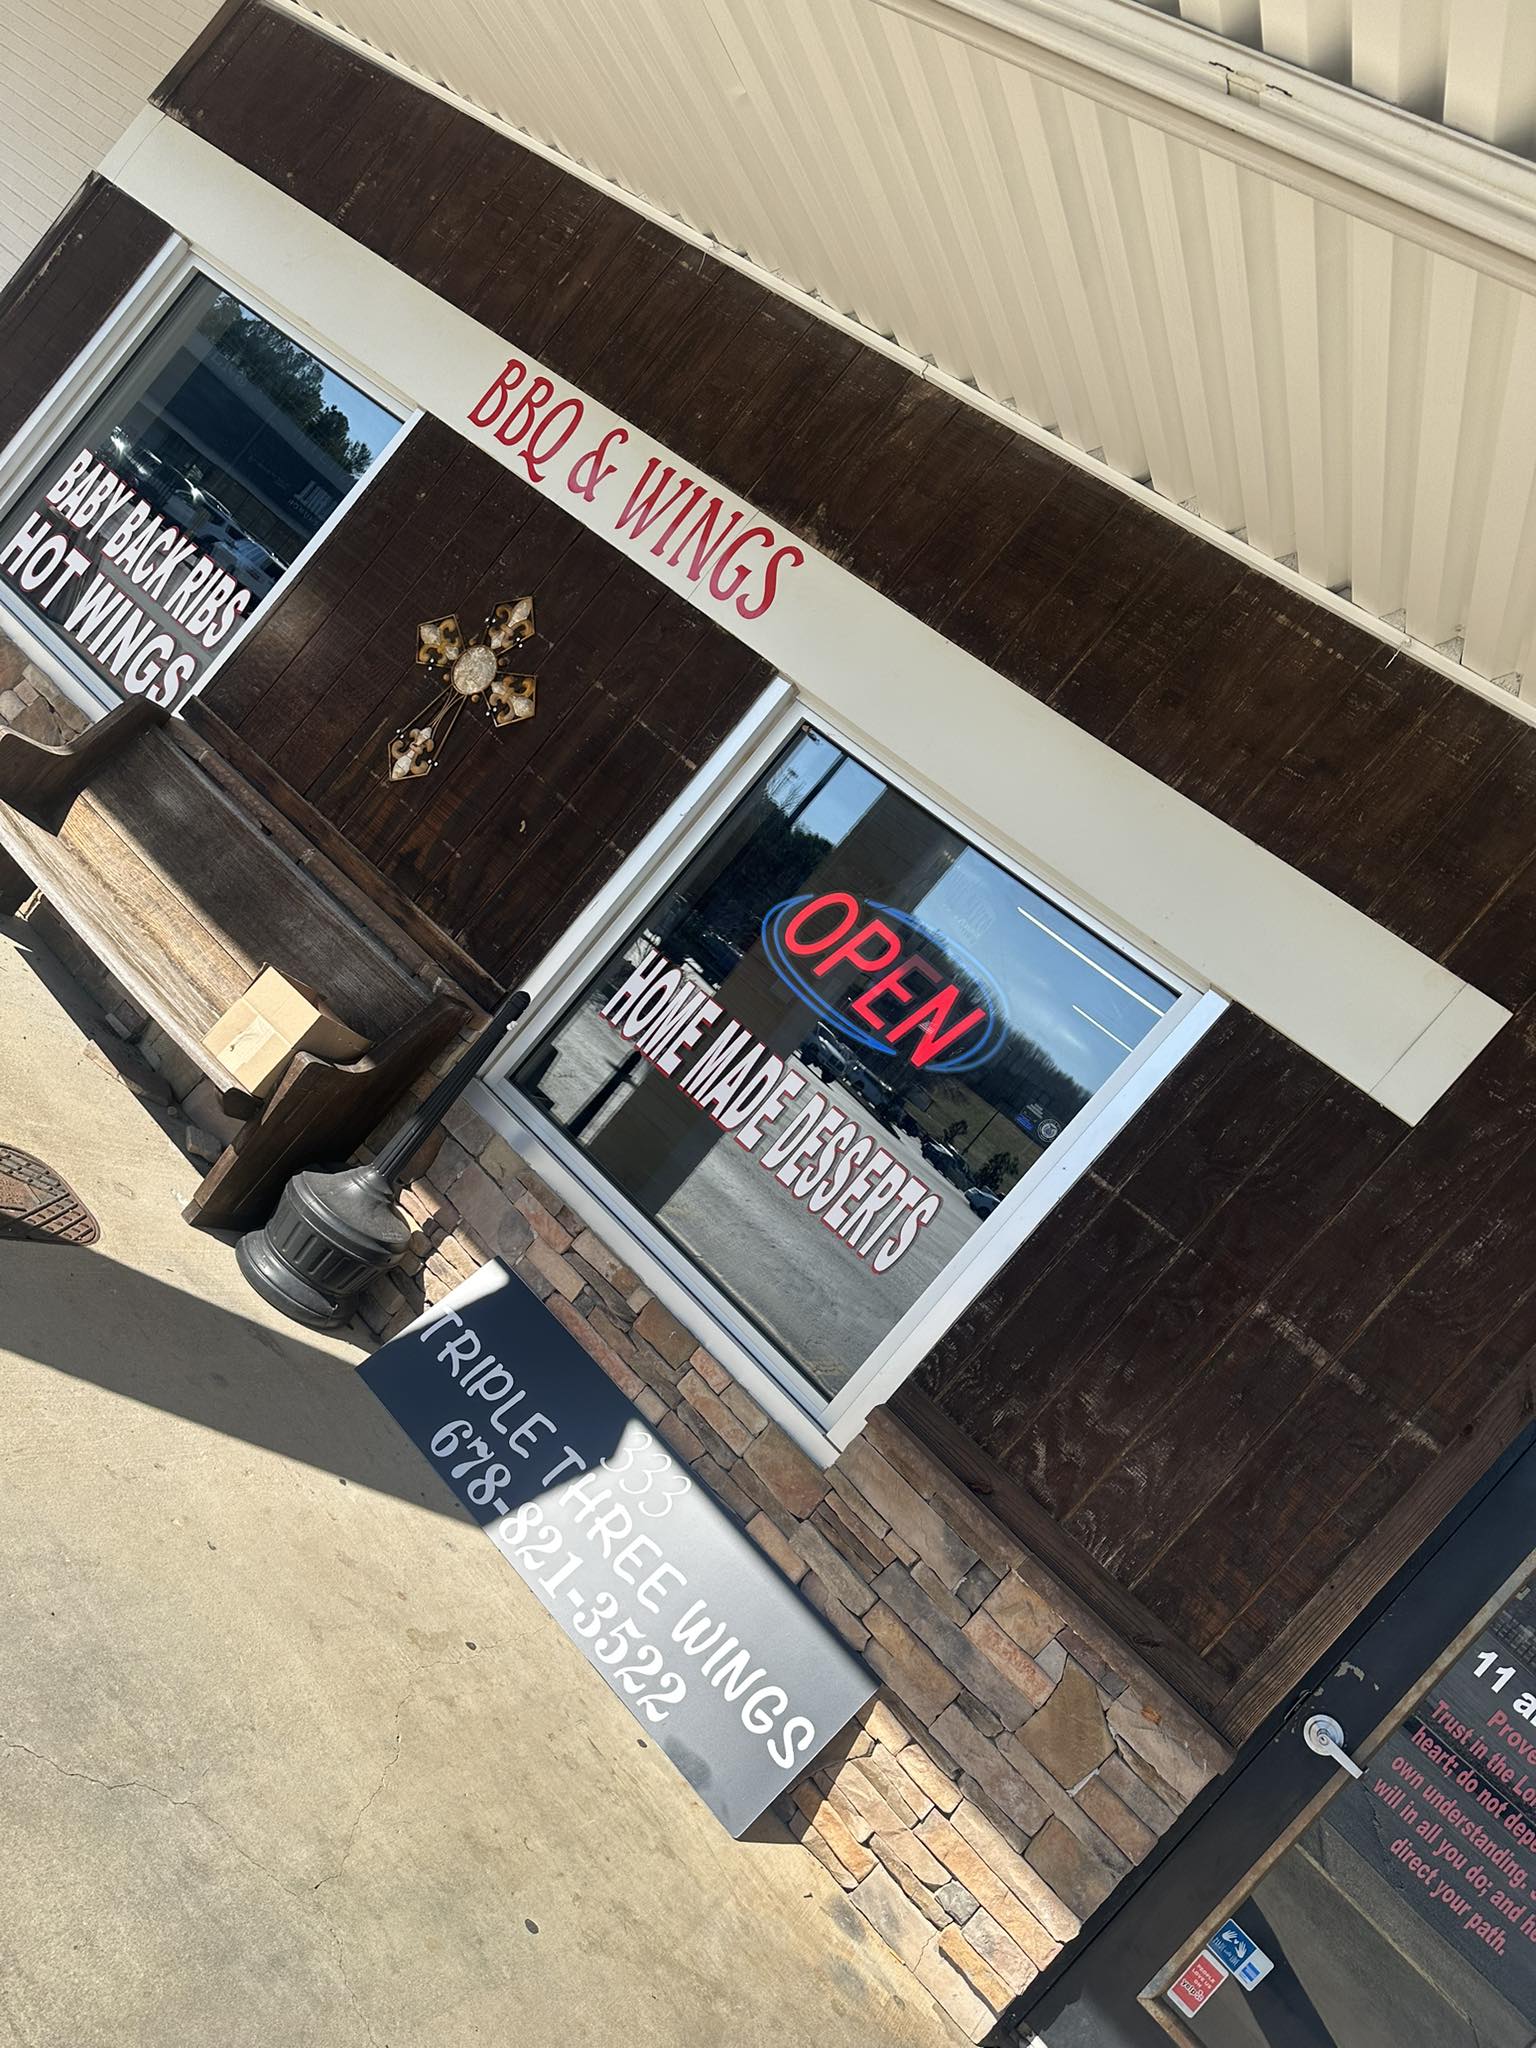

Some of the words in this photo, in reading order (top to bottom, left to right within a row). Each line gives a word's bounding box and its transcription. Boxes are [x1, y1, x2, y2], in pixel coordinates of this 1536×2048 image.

[45, 448, 136, 540] BABY
[101, 499, 199, 602] BACK
[163, 553, 250, 648] RIBS
[467, 359, 584, 483] BBQ
[567, 428, 629, 502] &
[615, 457, 804, 619] WINGS
[0, 511, 93, 609] HOT
[64, 572, 196, 708] WINGS
[784, 892, 986, 1069] OPEN
[600, 949, 724, 1078] HOME
[677, 1017, 807, 1152] MADE
[759, 1092, 943, 1274] DESSERTS
[419, 1306, 556, 1458] TRIPLE
[542, 1446, 687, 1614] THREE
[671, 1599, 815, 1770] WINGS
[600, 1431, 691, 1517] 333
[430, 1419, 686, 1722] 678-821-3522
[1431, 1699, 1475, 1746] Trust
[1469, 1735, 1489, 1760] in
[1486, 1752, 1515, 1783] the
[1473, 1651, 1517, 1694] 11
[1373, 1778, 1408, 1810] will
[1399, 1800, 1419, 1825] in
[1415, 1820, 1444, 1845] all
[1431, 1838, 1469, 1871] you
[1465, 1865, 1494, 1897] do;
[1489, 1890, 1528, 1922] and
[1391, 1757, 1425, 1790] own
[1422, 1784, 1528, 1889] understanding.
[1411, 1725, 1460, 1778] heart;
[1456, 1769, 1479, 1793] do
[1475, 1788, 1509, 1819] not
[1390, 1838, 1440, 1886] direct
[1429, 1879, 1473, 1916] your
[1463, 1912, 1507, 1956] path.
